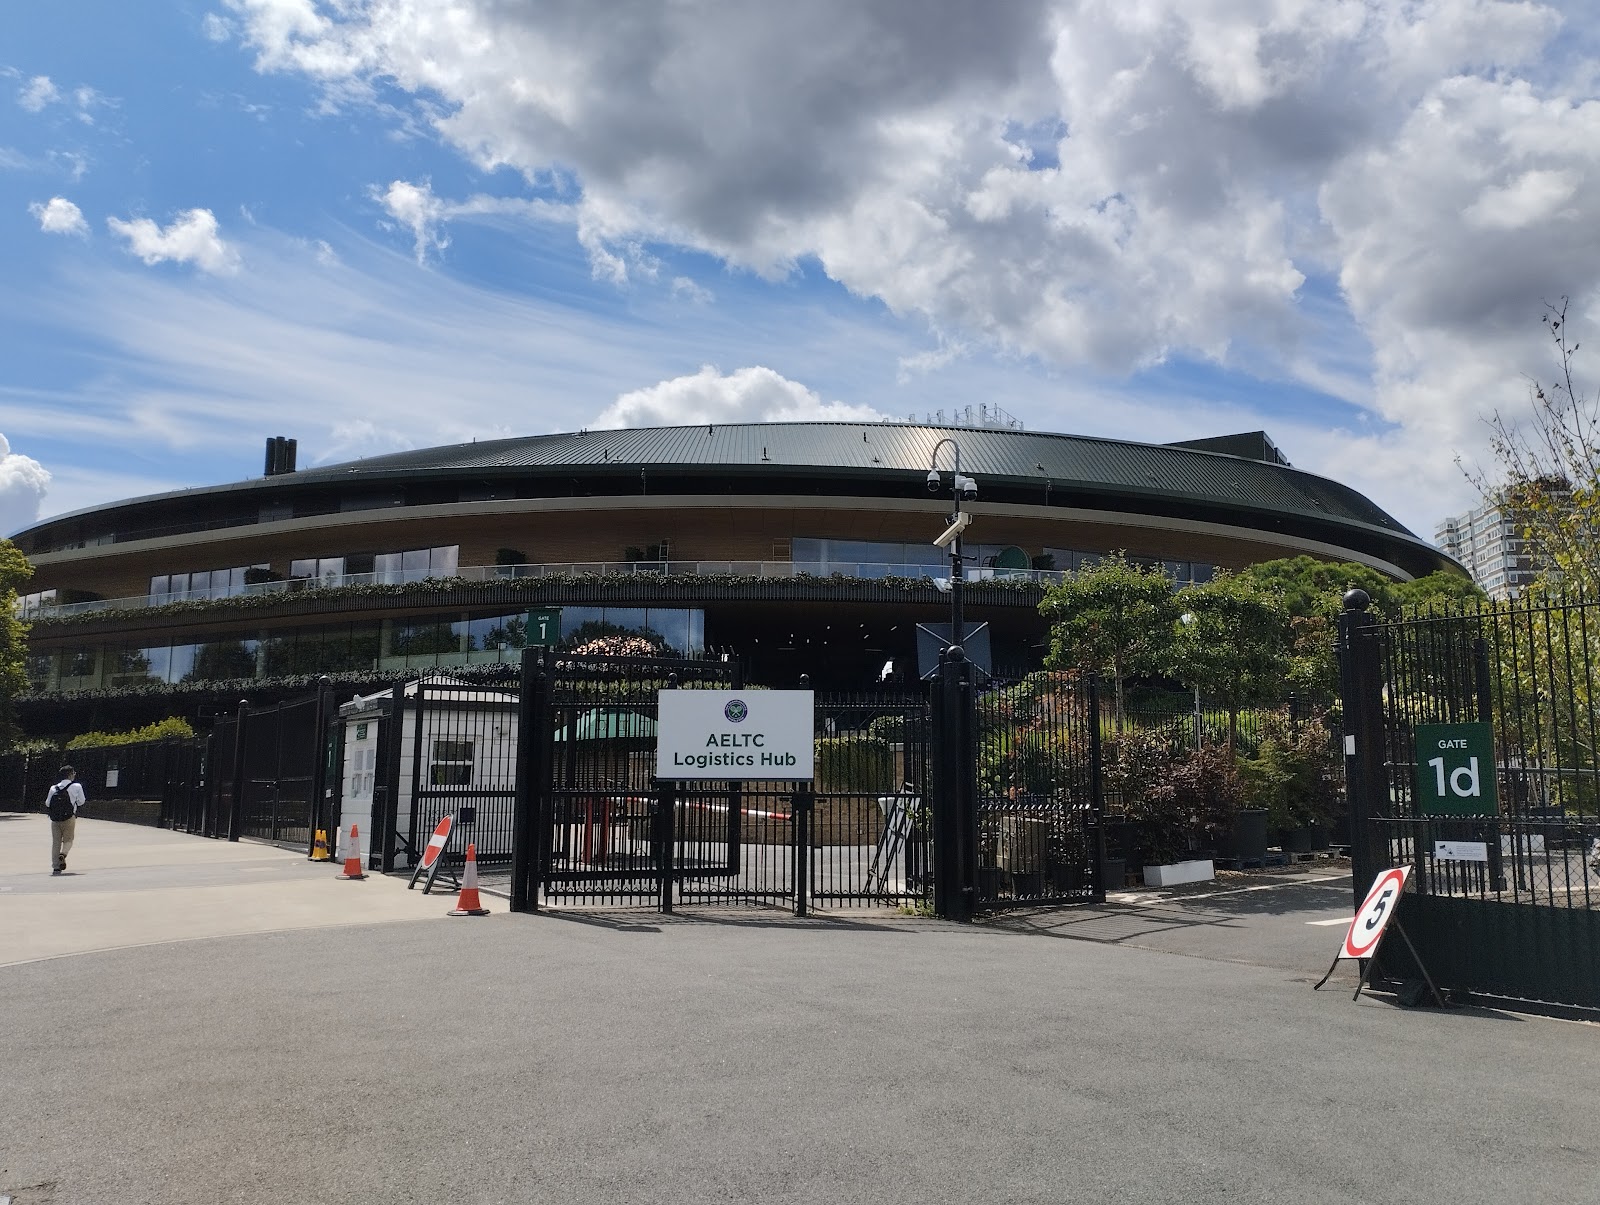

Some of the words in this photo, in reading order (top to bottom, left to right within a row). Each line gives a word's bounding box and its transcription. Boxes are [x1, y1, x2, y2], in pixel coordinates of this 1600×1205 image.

[539, 622, 546, 640] 1
[706, 733, 765, 747] AELTC
[1438, 739, 1468, 749] GATE
[674, 752, 754, 769] Logistics
[760, 752, 797, 766] Hub
[1428, 756, 1481, 798] 1d
[1365, 889, 1394, 931] 5
